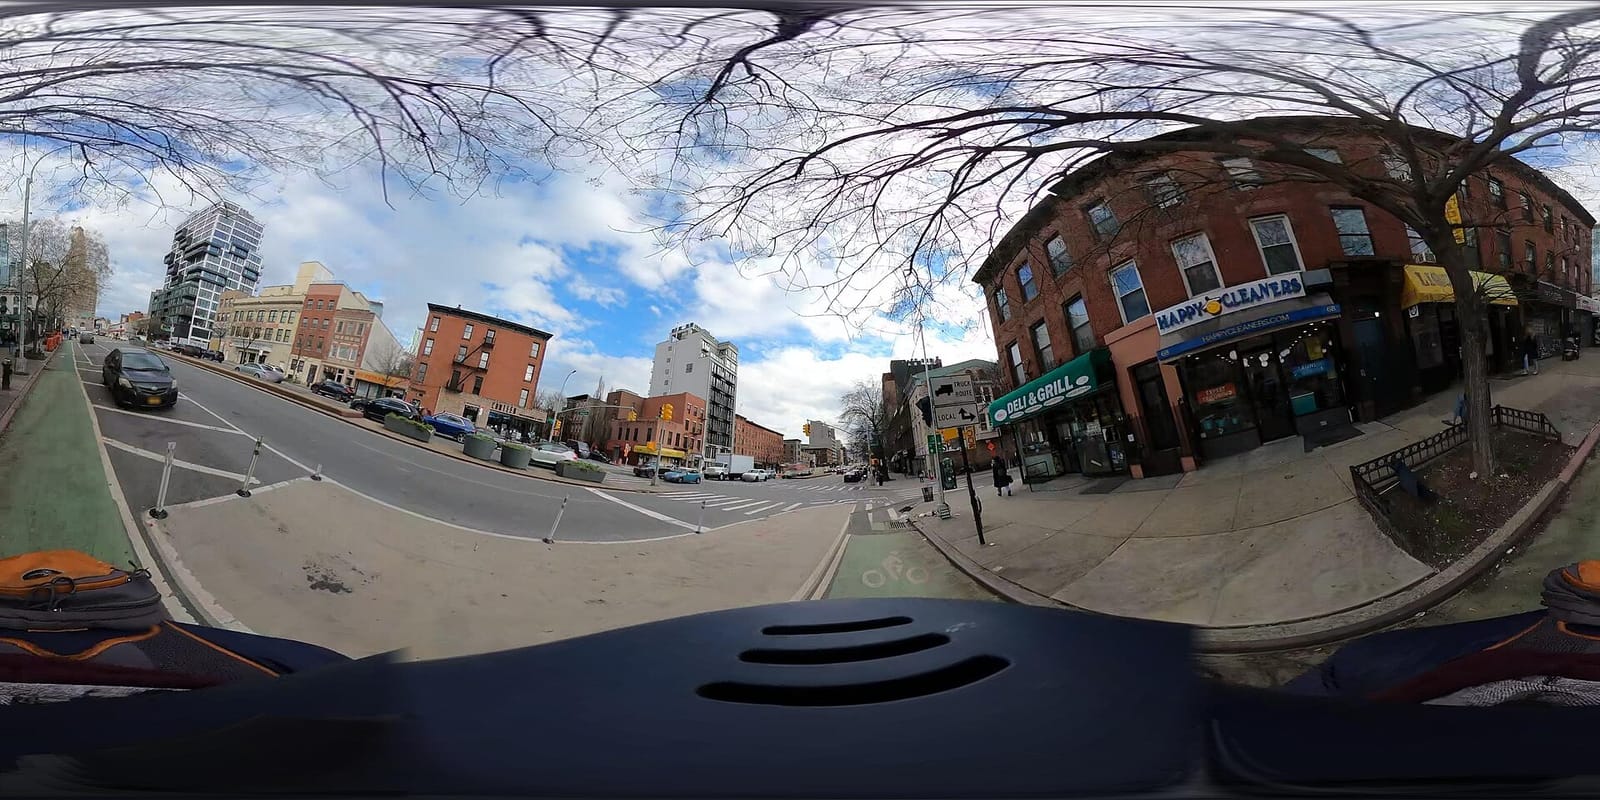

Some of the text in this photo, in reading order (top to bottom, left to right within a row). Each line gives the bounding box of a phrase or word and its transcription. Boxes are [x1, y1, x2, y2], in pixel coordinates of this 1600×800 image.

[1157, 277, 1302, 330] HAPPY CLEANERS
[1201, 313, 1289, 343] HAPPYCLEANERS.COM
[1007, 395, 1027, 414] DELI
[1028, 392, 1037, 406] &
[1037, 375, 1074, 402] GRILL
[937, 413, 957, 421] LOCAL
